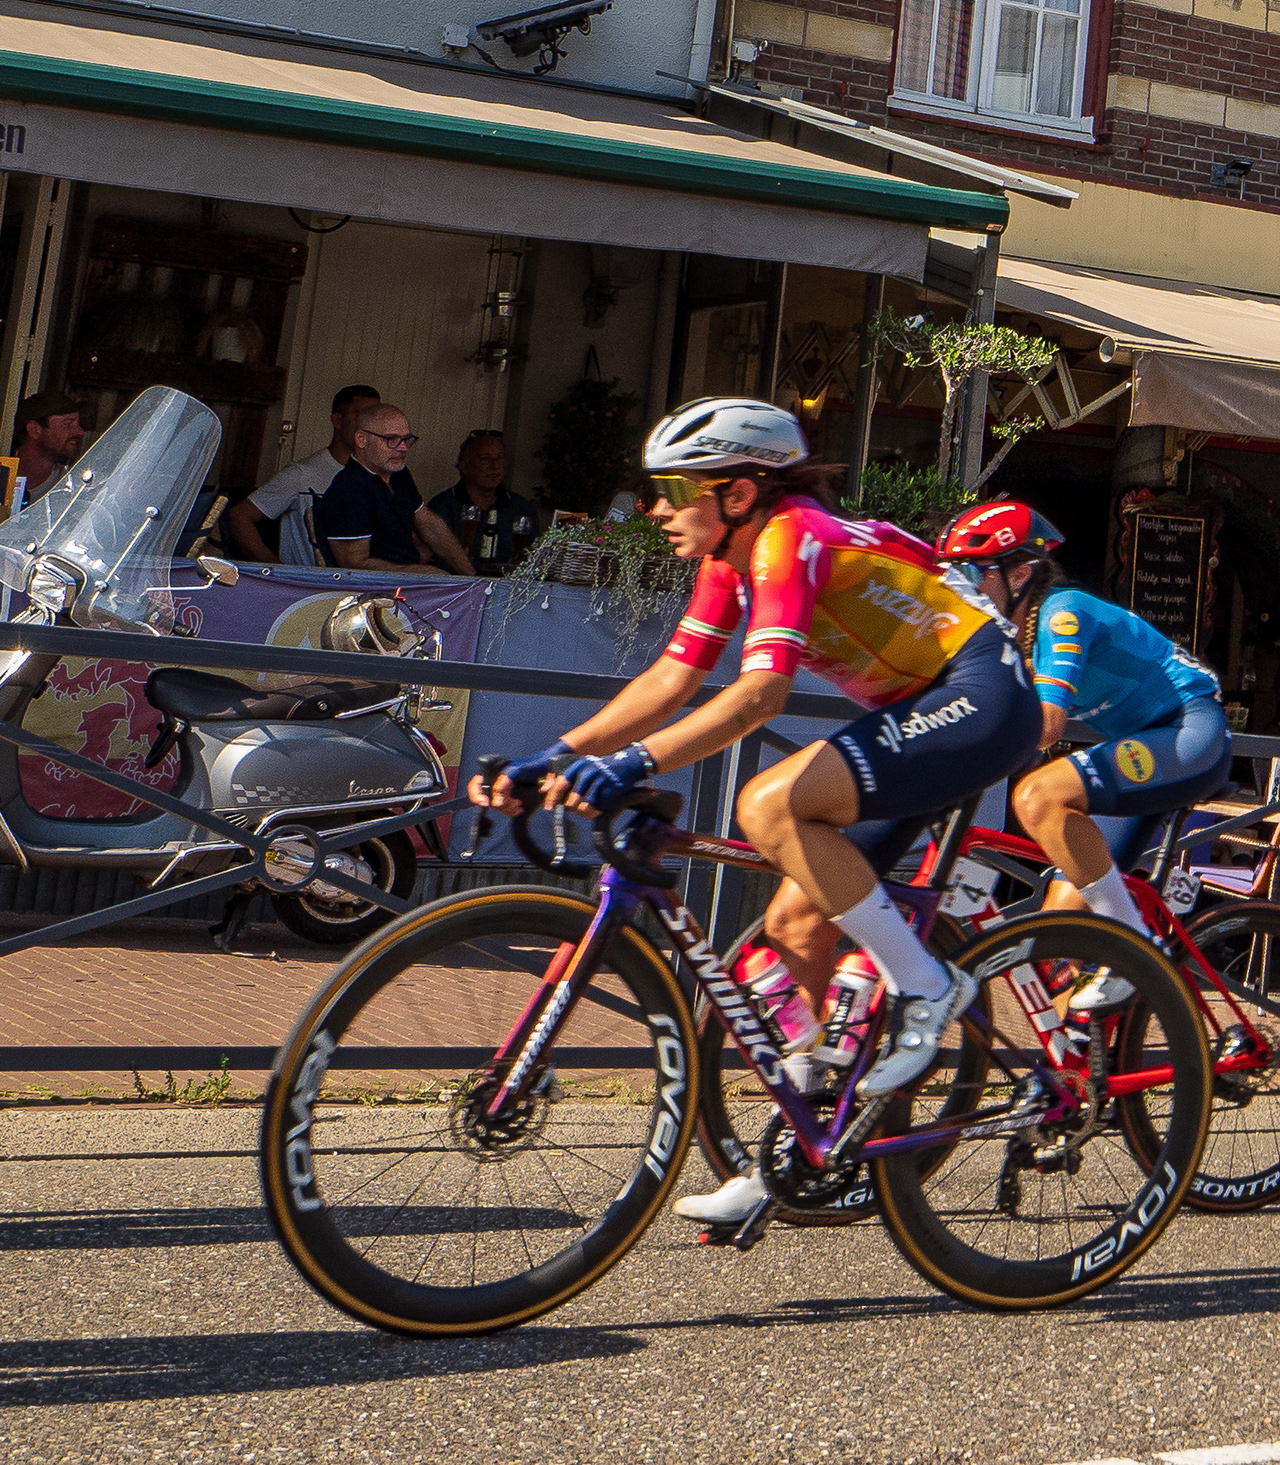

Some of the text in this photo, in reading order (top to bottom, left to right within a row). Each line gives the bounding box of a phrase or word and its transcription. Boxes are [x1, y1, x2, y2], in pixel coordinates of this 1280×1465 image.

[902, 695, 978, 739] sdworx
[962, 884, 988, 905] 4
[1172, 876, 1196, 907] 62
[659, 905, 784, 1086] S-WORKS
[645, 1012, 687, 1182] roval
[1071, 1161, 1178, 1282] roval
